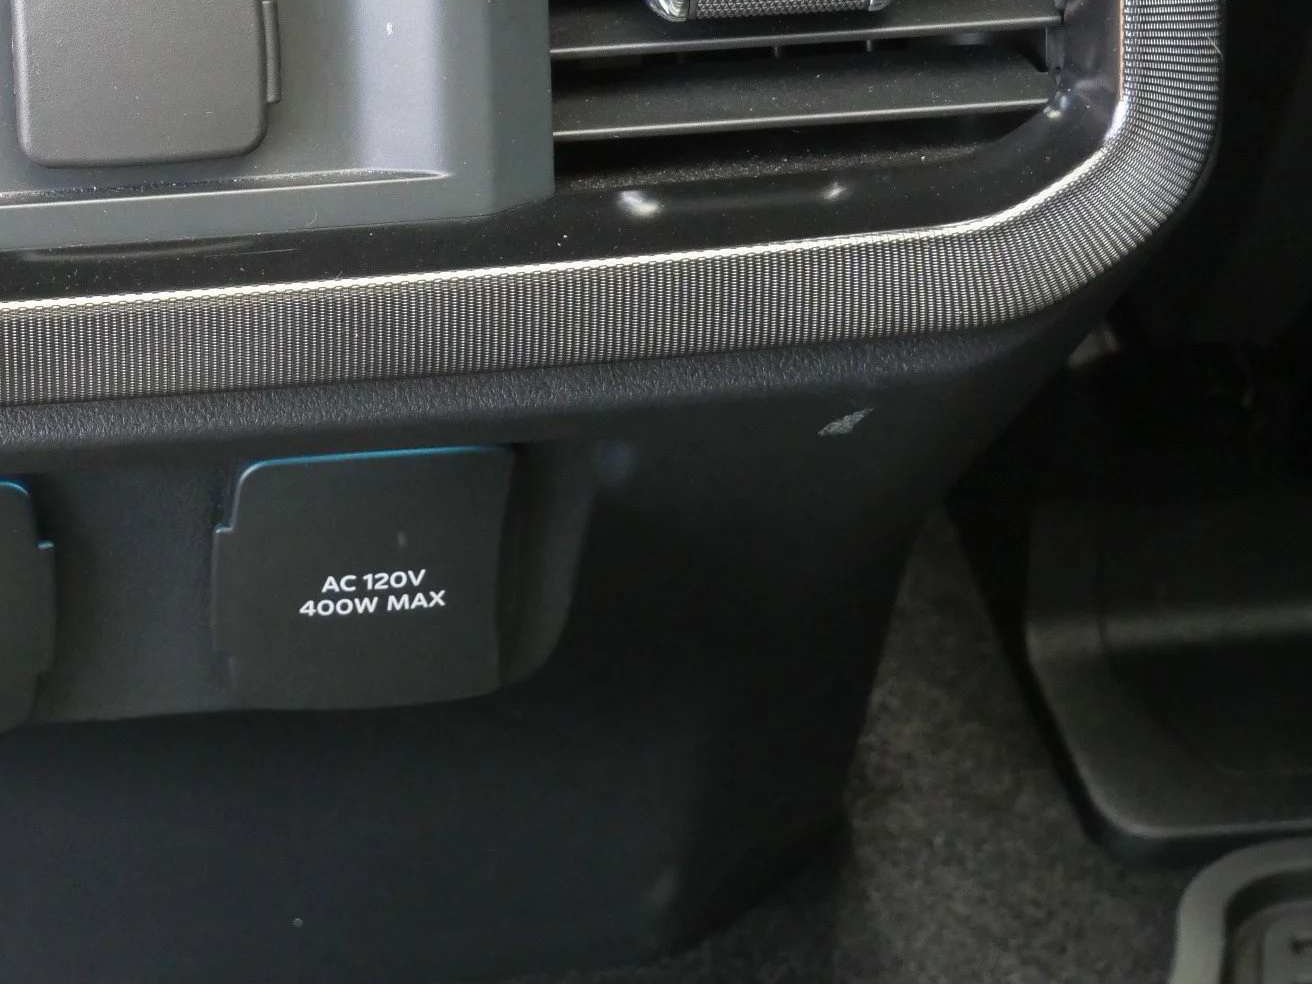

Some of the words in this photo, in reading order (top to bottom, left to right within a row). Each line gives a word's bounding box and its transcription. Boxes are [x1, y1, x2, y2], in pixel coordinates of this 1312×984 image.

[321, 574, 357, 593] AC
[362, 568, 426, 590] 120V
[299, 596, 378, 617] 400W
[386, 589, 446, 612] MAX
